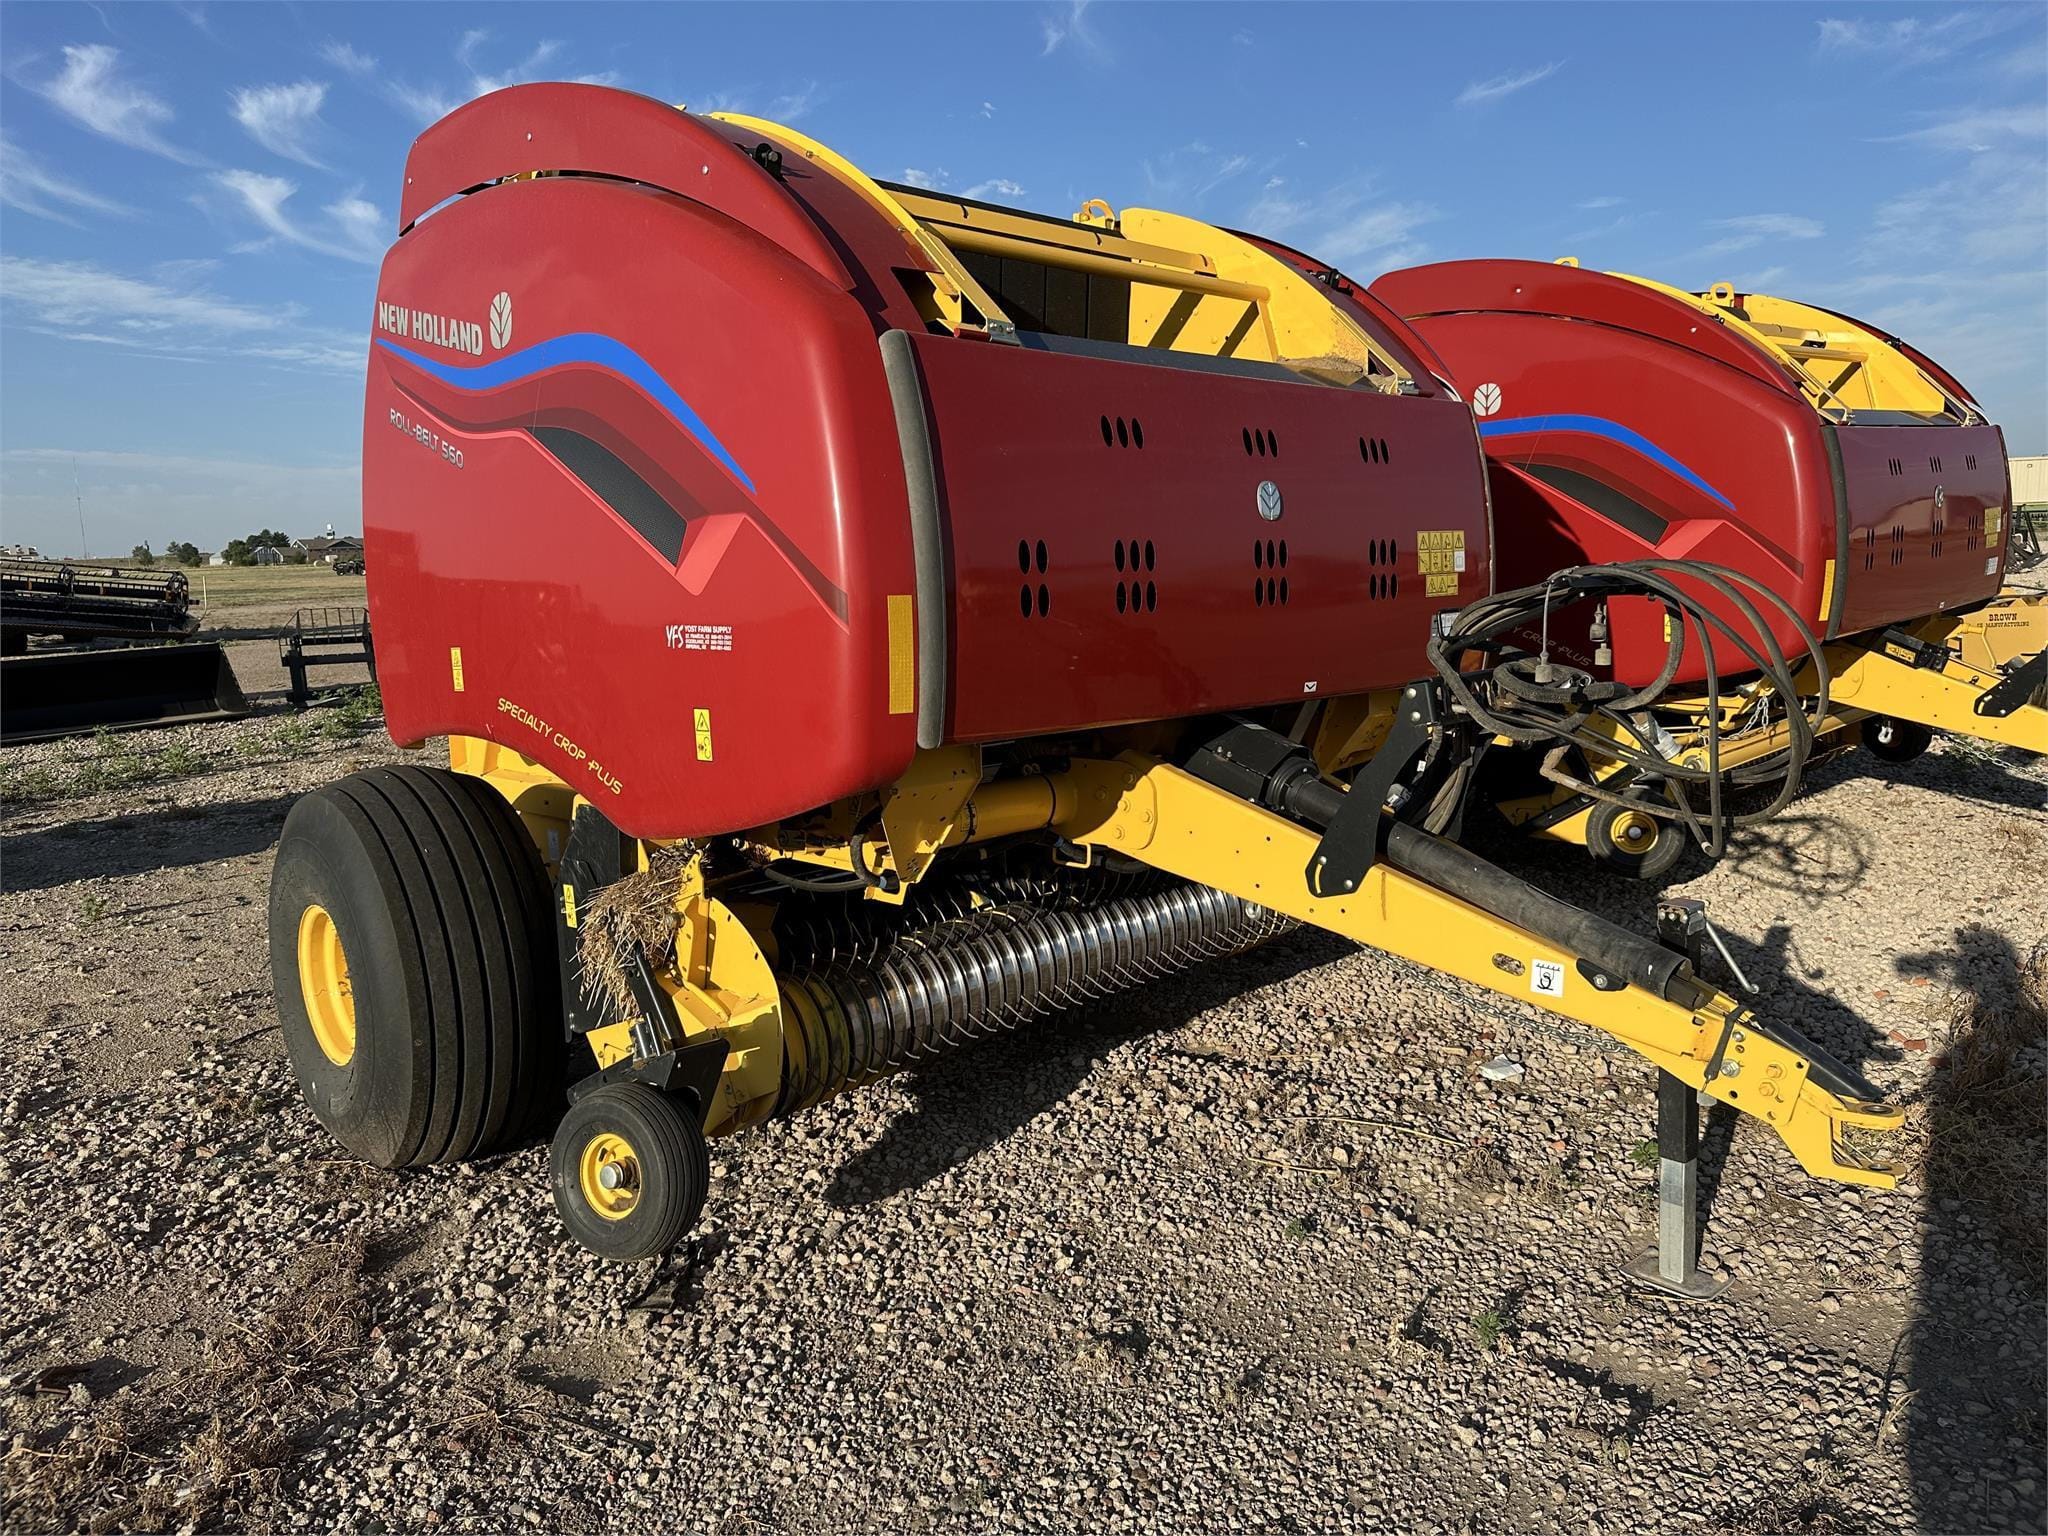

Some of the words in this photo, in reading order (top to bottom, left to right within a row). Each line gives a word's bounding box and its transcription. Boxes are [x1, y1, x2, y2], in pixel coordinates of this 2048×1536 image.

[379, 301, 409, 337] NEW
[412, 310, 483, 356] HOLLAND
[390, 408, 439, 452] ROLL-BELT
[441, 440, 464, 469] 560
[665, 624, 684, 649] YFS
[684, 625, 698, 633] YOST
[712, 626, 732, 634] SUPPLY
[1989, 613, 2018, 622] BROWN
[497, 697, 554, 738] SPECIALTY
[553, 732, 587, 762] CROP
